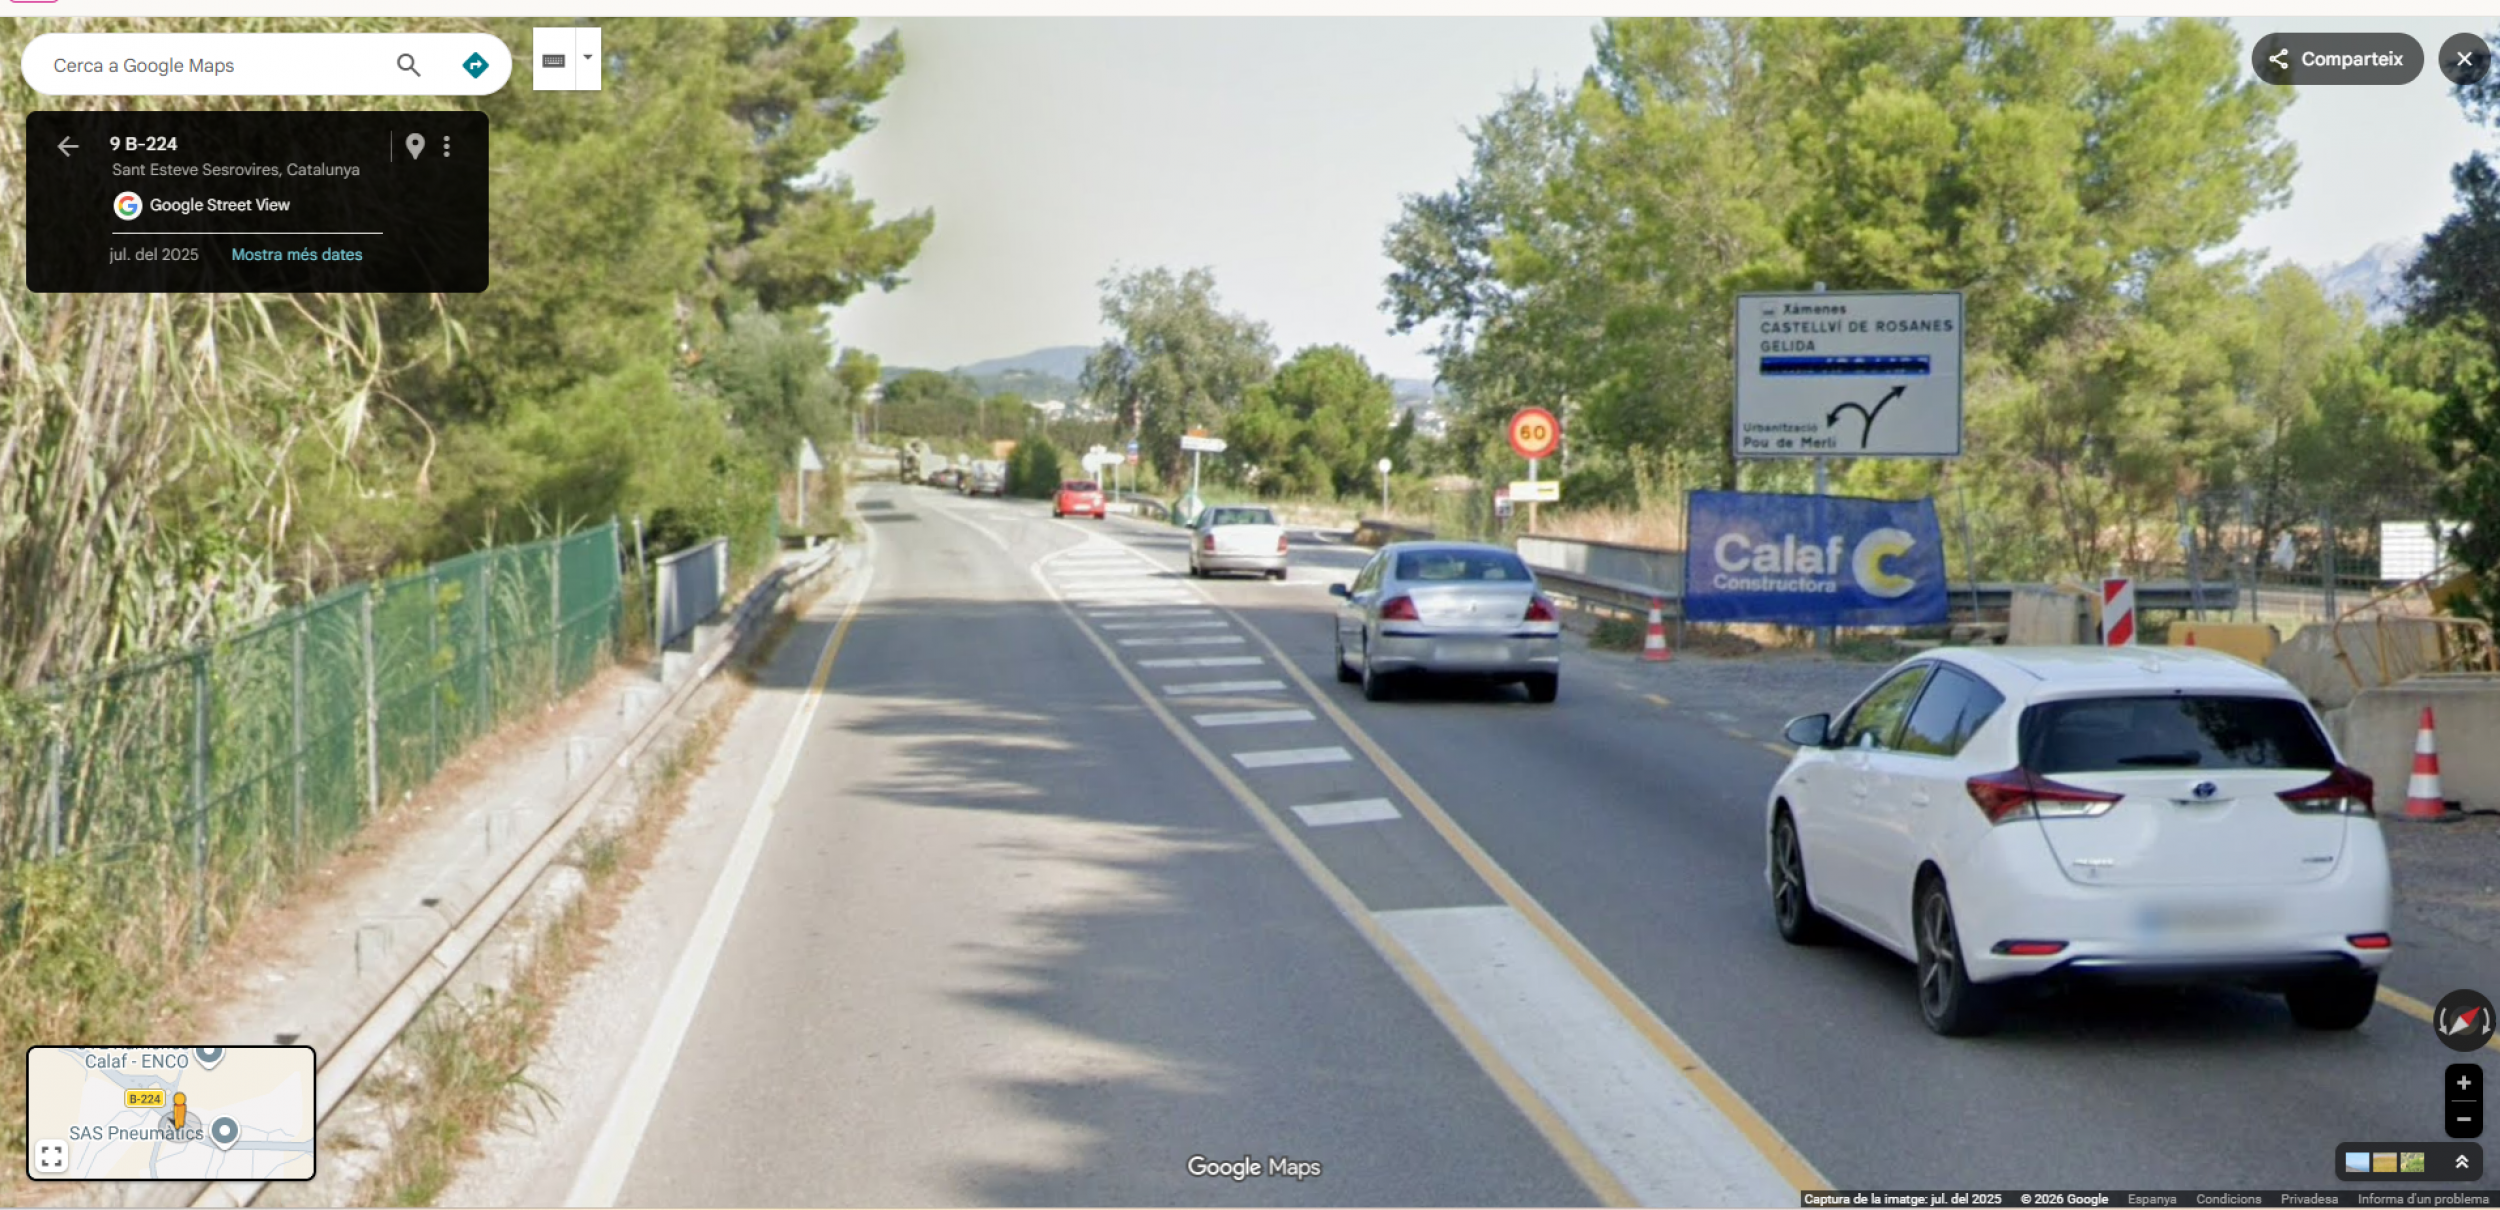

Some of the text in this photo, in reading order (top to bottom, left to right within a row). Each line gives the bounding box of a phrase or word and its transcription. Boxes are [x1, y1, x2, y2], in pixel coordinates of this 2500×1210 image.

[1760, 319, 1954, 333] CASTELLVÍ DE ROSANES
[1760, 340, 1816, 352] GELIDA
[1520, 425, 1546, 440] 60
[1743, 436, 1769, 448] Pou
[1776, 437, 1793, 448] de
[1713, 532, 1844, 575] Calaf
[1713, 573, 1837, 593] Constructora
